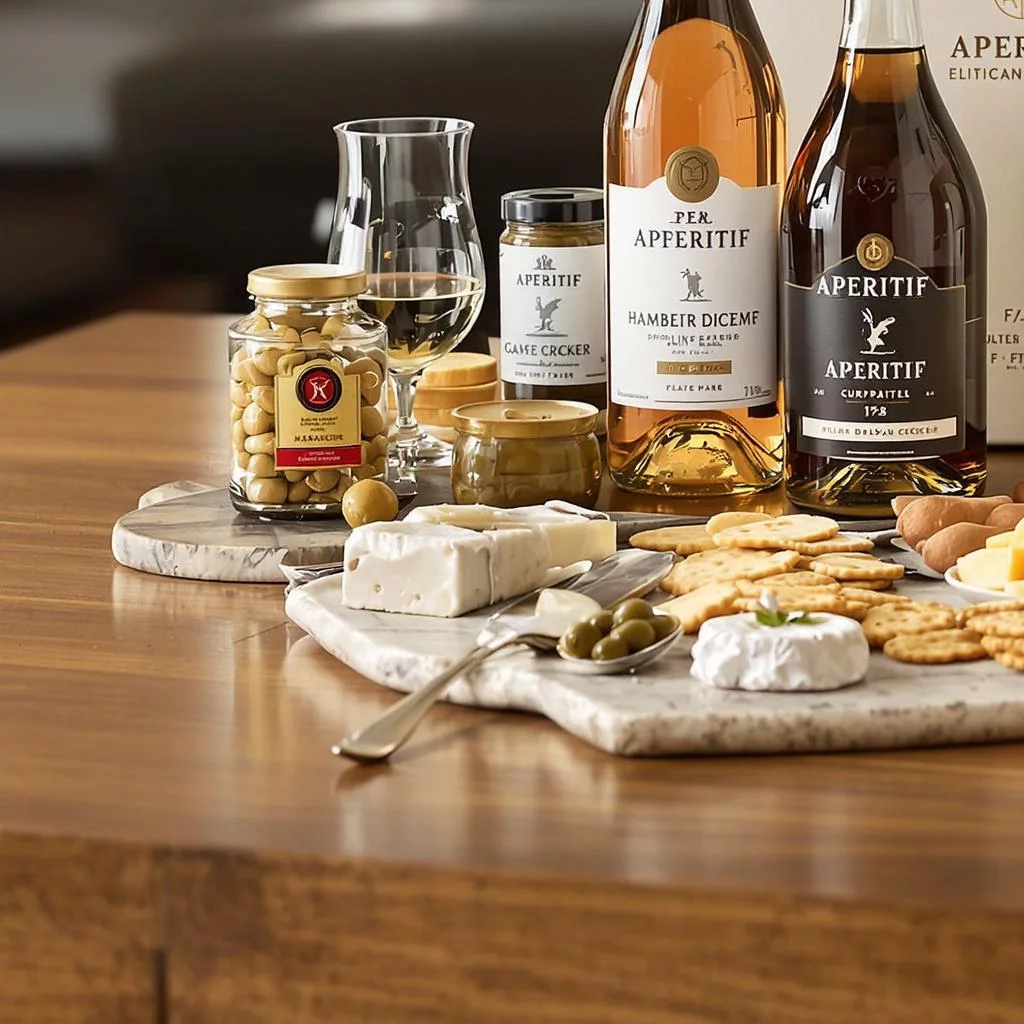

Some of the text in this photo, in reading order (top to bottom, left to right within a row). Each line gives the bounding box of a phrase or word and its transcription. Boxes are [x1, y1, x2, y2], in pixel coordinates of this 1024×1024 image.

[949, 68, 1022, 80] ELITICAN
[516, 274, 582, 287] APERITIF
[816, 275, 930, 297] APERITIF
[824, 360, 927, 380] APERITIF
